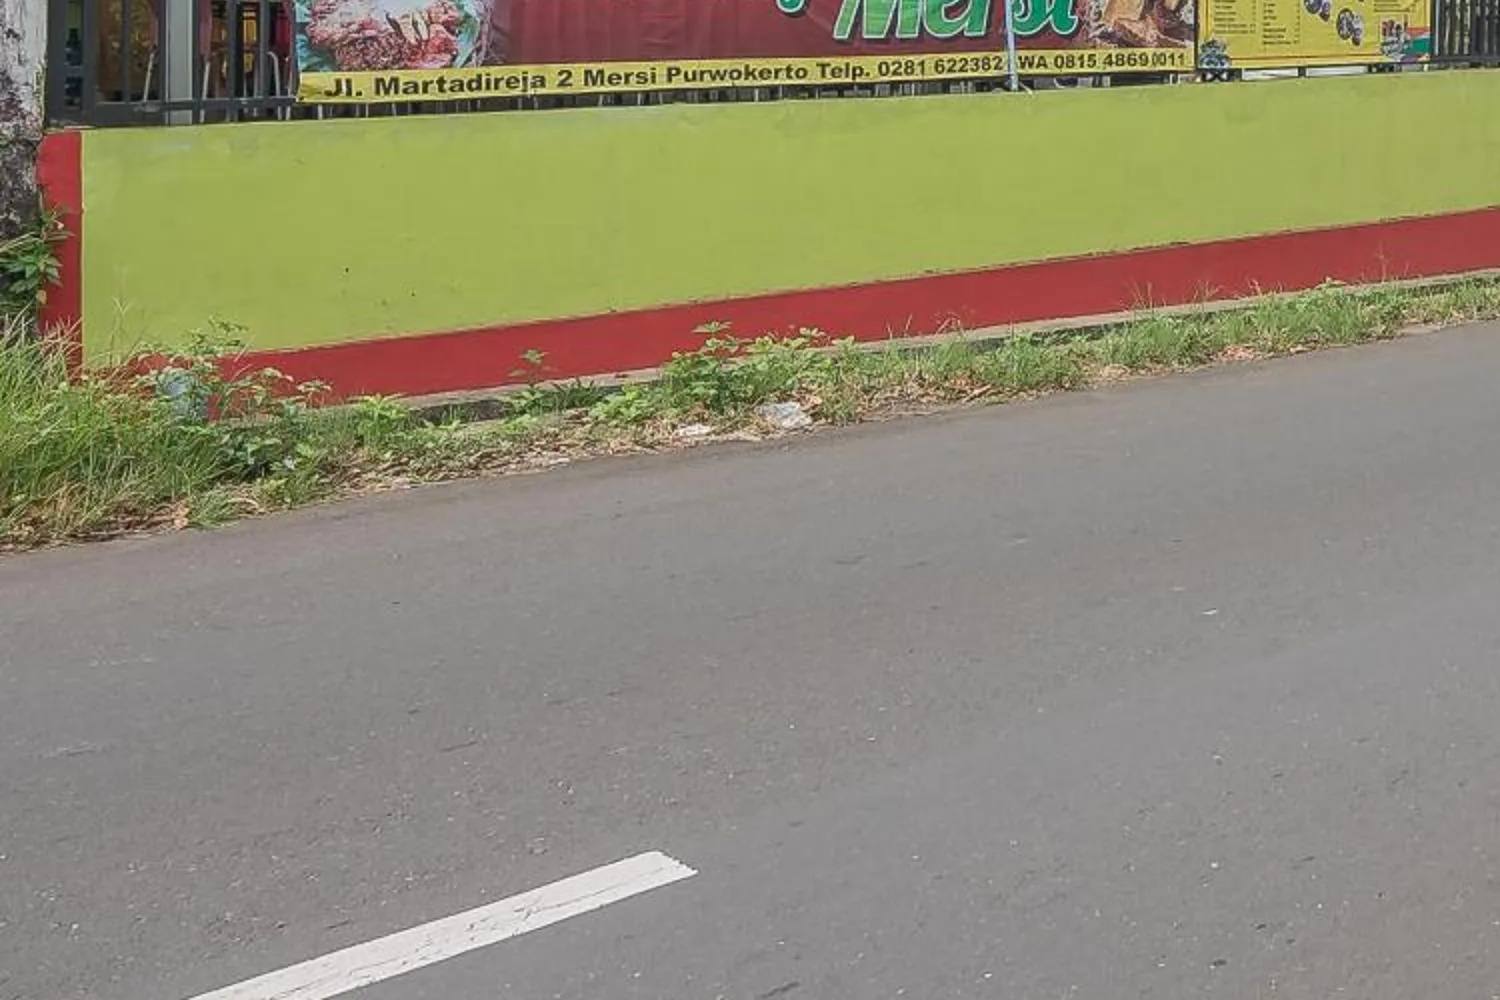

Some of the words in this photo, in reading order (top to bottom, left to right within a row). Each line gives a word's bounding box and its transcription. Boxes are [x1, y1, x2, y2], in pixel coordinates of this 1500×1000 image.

[323, 77, 363, 97] Jl.
[375, 69, 547, 96] Martadireja
[556, 69, 574, 88] 2
[583, 67, 658, 87] Mersi
[666, 63, 809, 84] Purwokerto
[816, 61, 871, 82] Telp.
[878, 59, 926, 78] 0281
[934, 54, 1004, 75] 622382
[1018, 55, 1049, 70] WA
[1054, 53, 1098, 69] 0815
